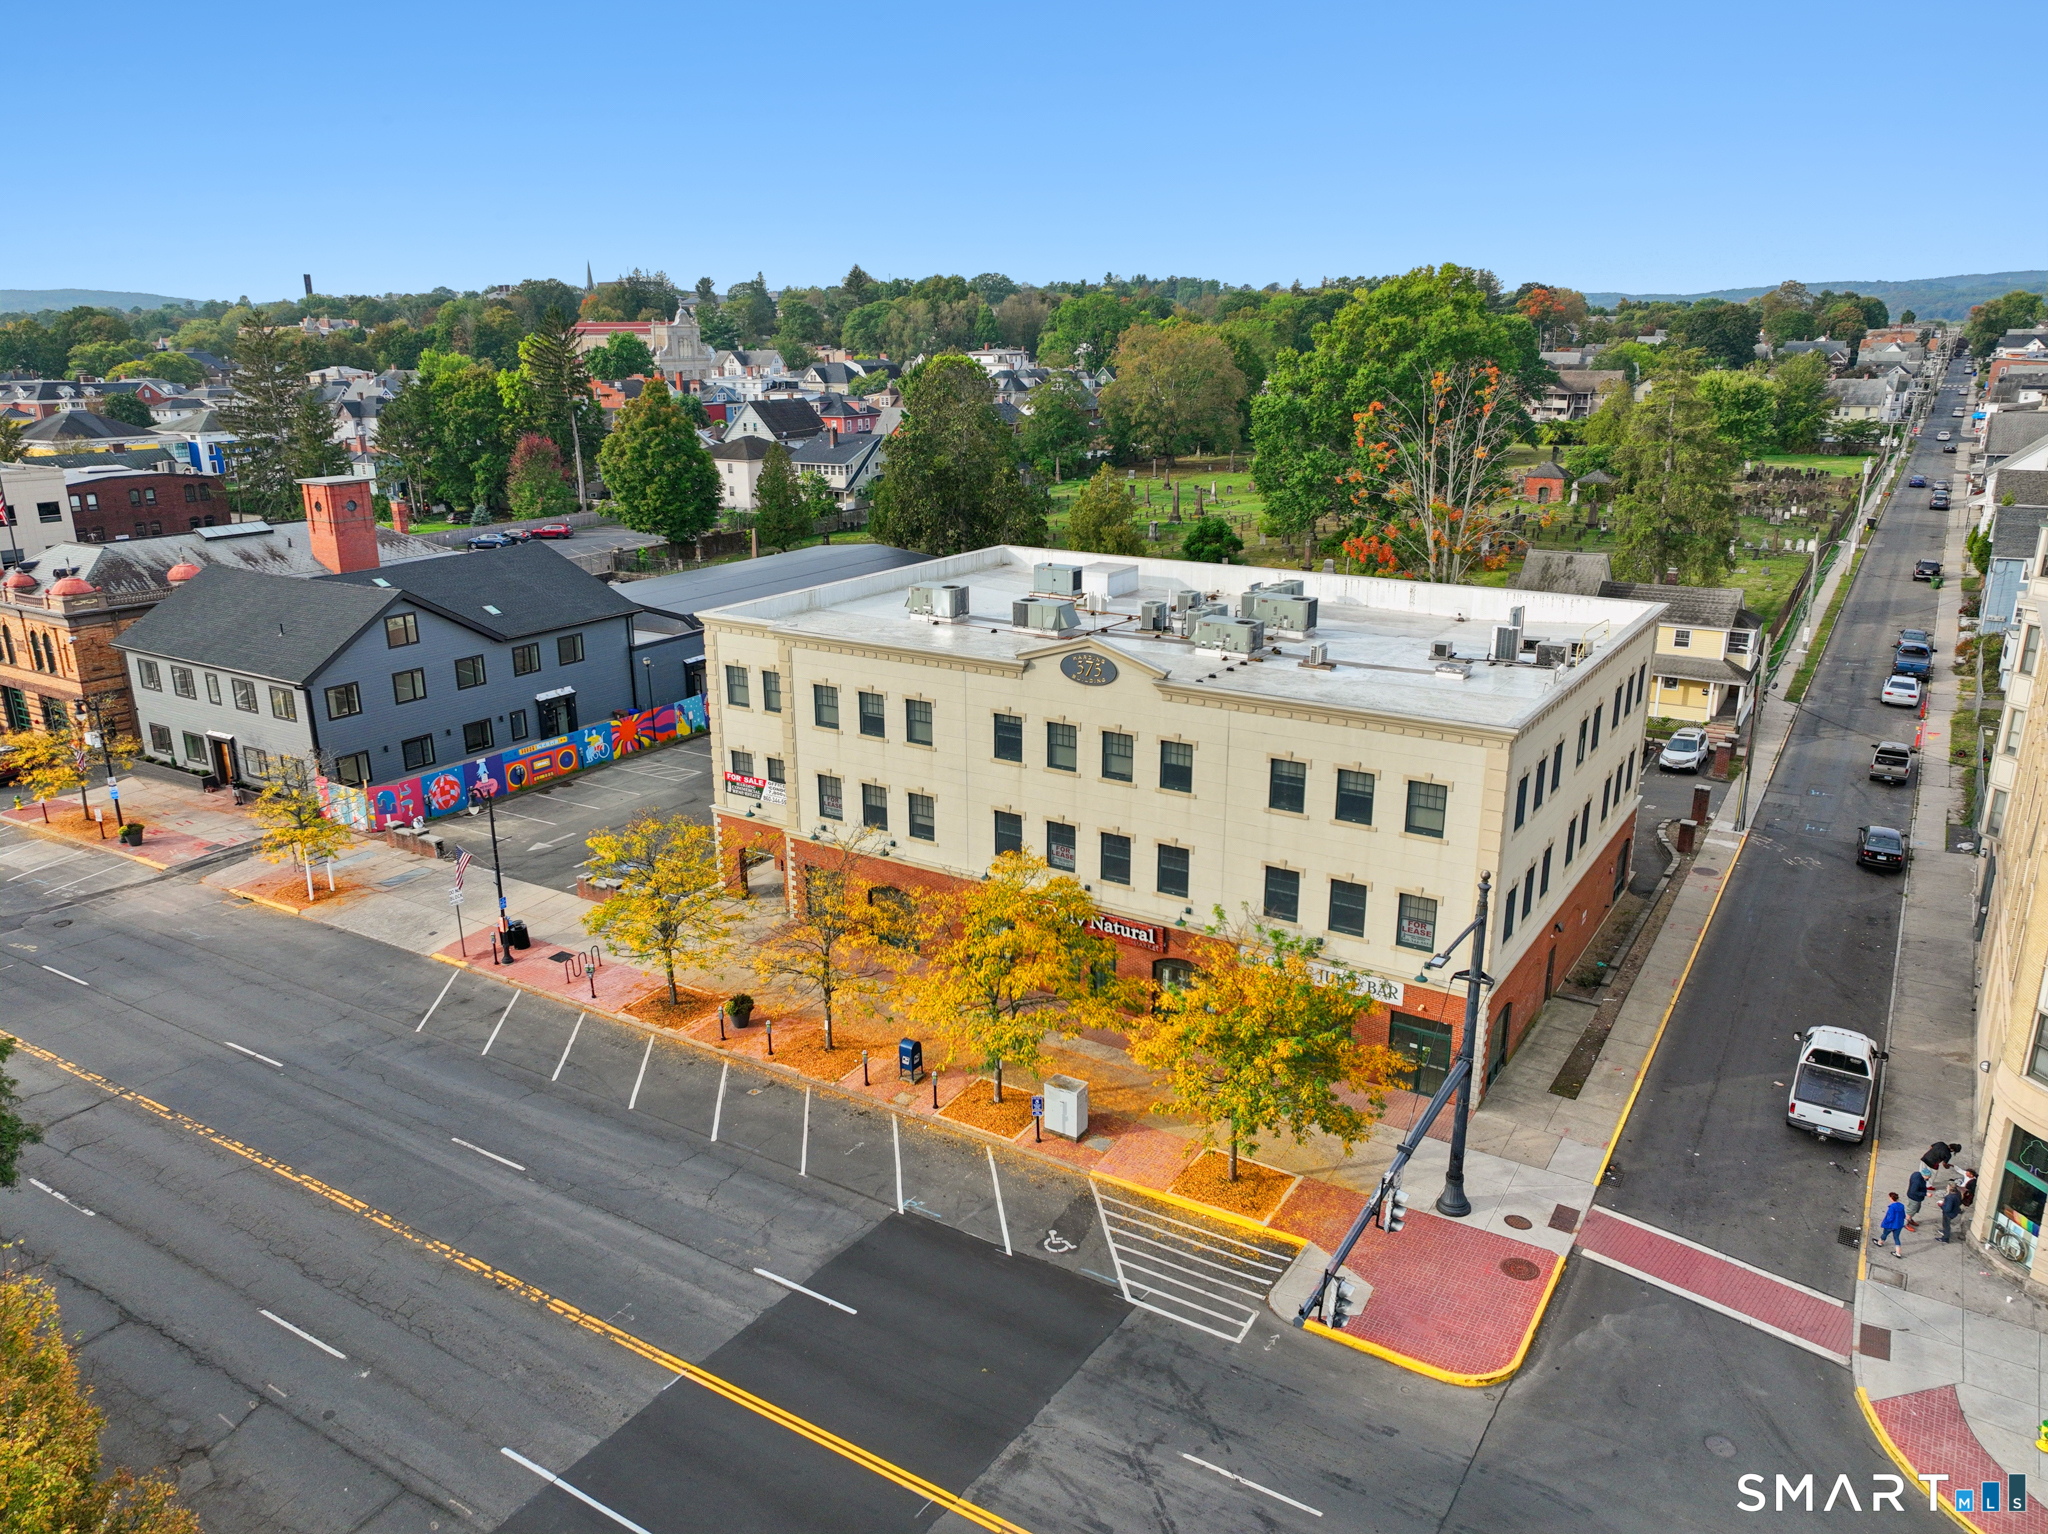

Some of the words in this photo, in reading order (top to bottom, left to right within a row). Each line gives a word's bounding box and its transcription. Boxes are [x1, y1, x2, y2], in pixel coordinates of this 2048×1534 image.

[1076, 660, 1102, 677] 575
[1071, 674, 1106, 684] BUILDING
[726, 773, 741, 782] FOR
[743, 776, 764, 787] SALE
[823, 800, 842, 810] LEASE
[1051, 850, 1074, 861] LEASE
[1056, 845, 1071, 854] FOR
[1089, 915, 1156, 944] Natural
[1407, 920, 1428, 930] FOR
[1402, 925, 1432, 938] LEASE
[1367, 979, 1399, 1001] BAR
